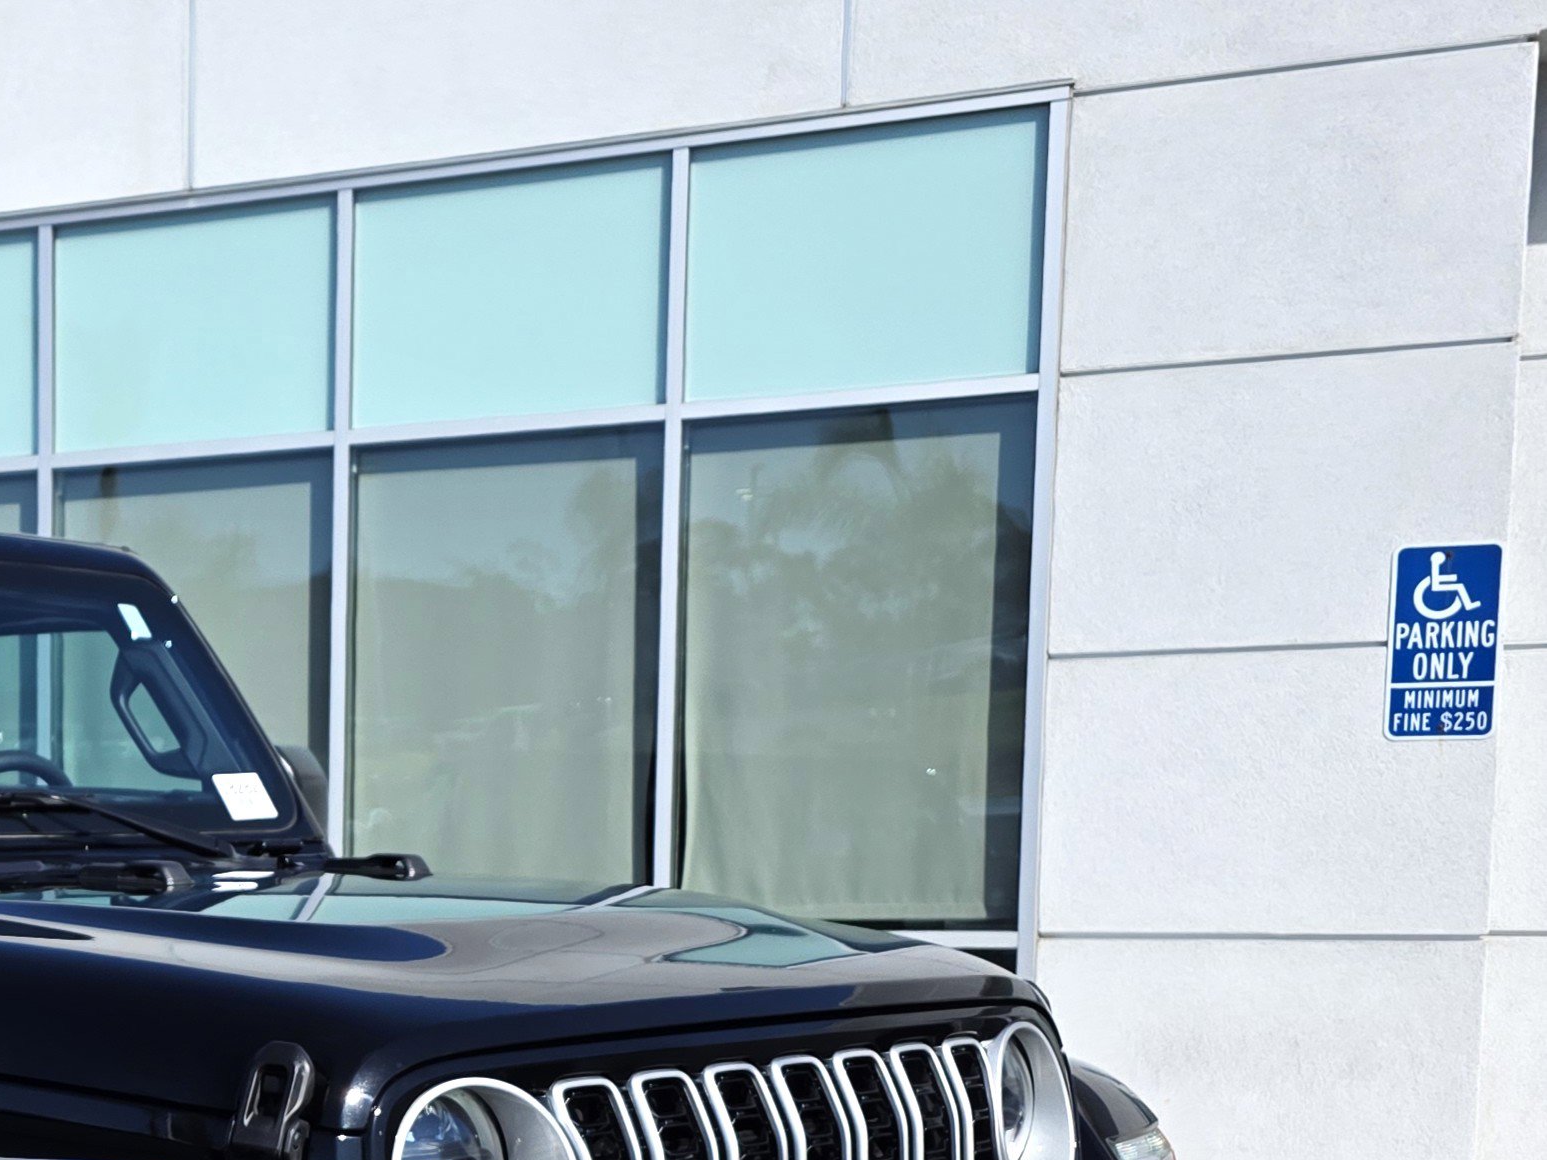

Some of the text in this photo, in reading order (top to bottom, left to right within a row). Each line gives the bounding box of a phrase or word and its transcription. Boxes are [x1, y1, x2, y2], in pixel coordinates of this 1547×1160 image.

[1395, 620, 1496, 650] PARKING
[1412, 652, 1474, 681] ONLY
[1404, 689, 1479, 710] MINIMUM
[1393, 710, 1488, 732] FINE $250
